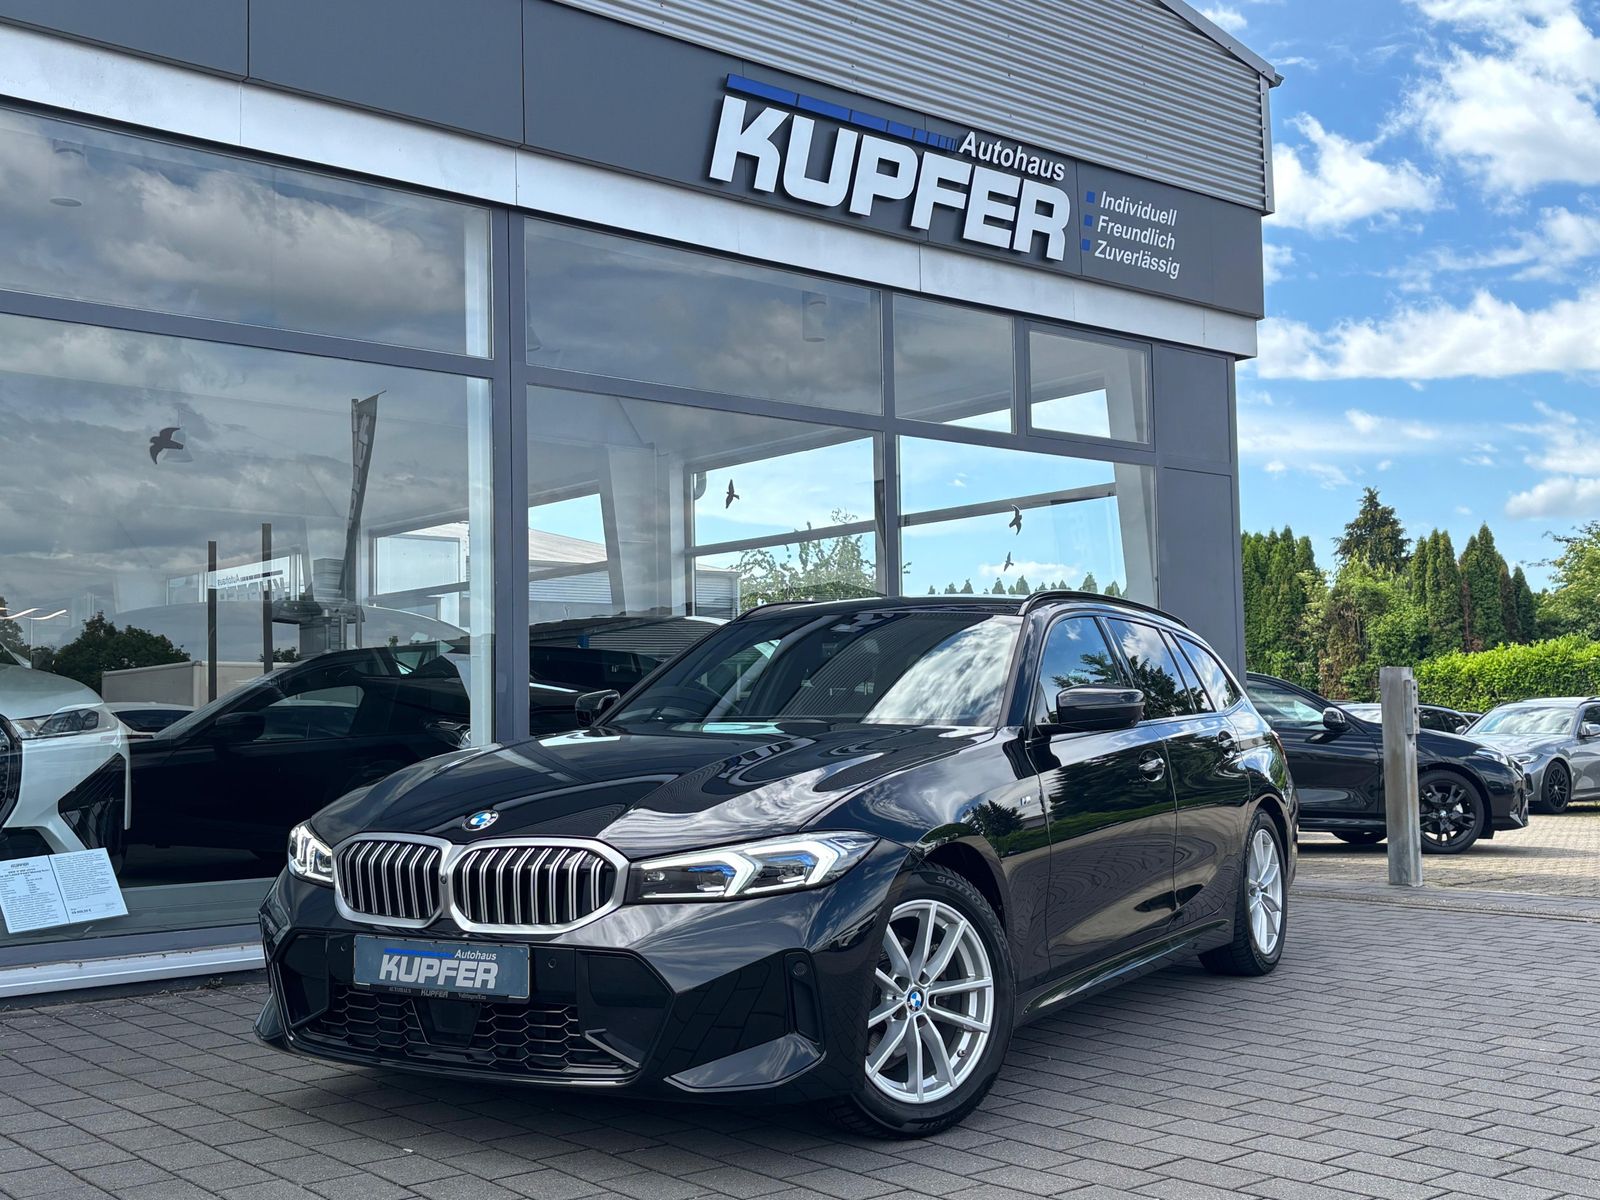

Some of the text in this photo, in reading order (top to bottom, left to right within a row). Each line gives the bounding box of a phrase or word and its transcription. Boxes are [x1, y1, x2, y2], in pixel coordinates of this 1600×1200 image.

[959, 131, 1066, 182] Autohaus
[709, 94, 1071, 262] KUPFER
[1100, 191, 1178, 227] Individuell
[1097, 215, 1176, 250] Freundlich
[1094, 239, 1180, 280] Zuverlässig
[379, 954, 499, 989] KUPFER
[454, 949, 497, 961] Autohaus
[420, 988, 449, 999] KUPFER
